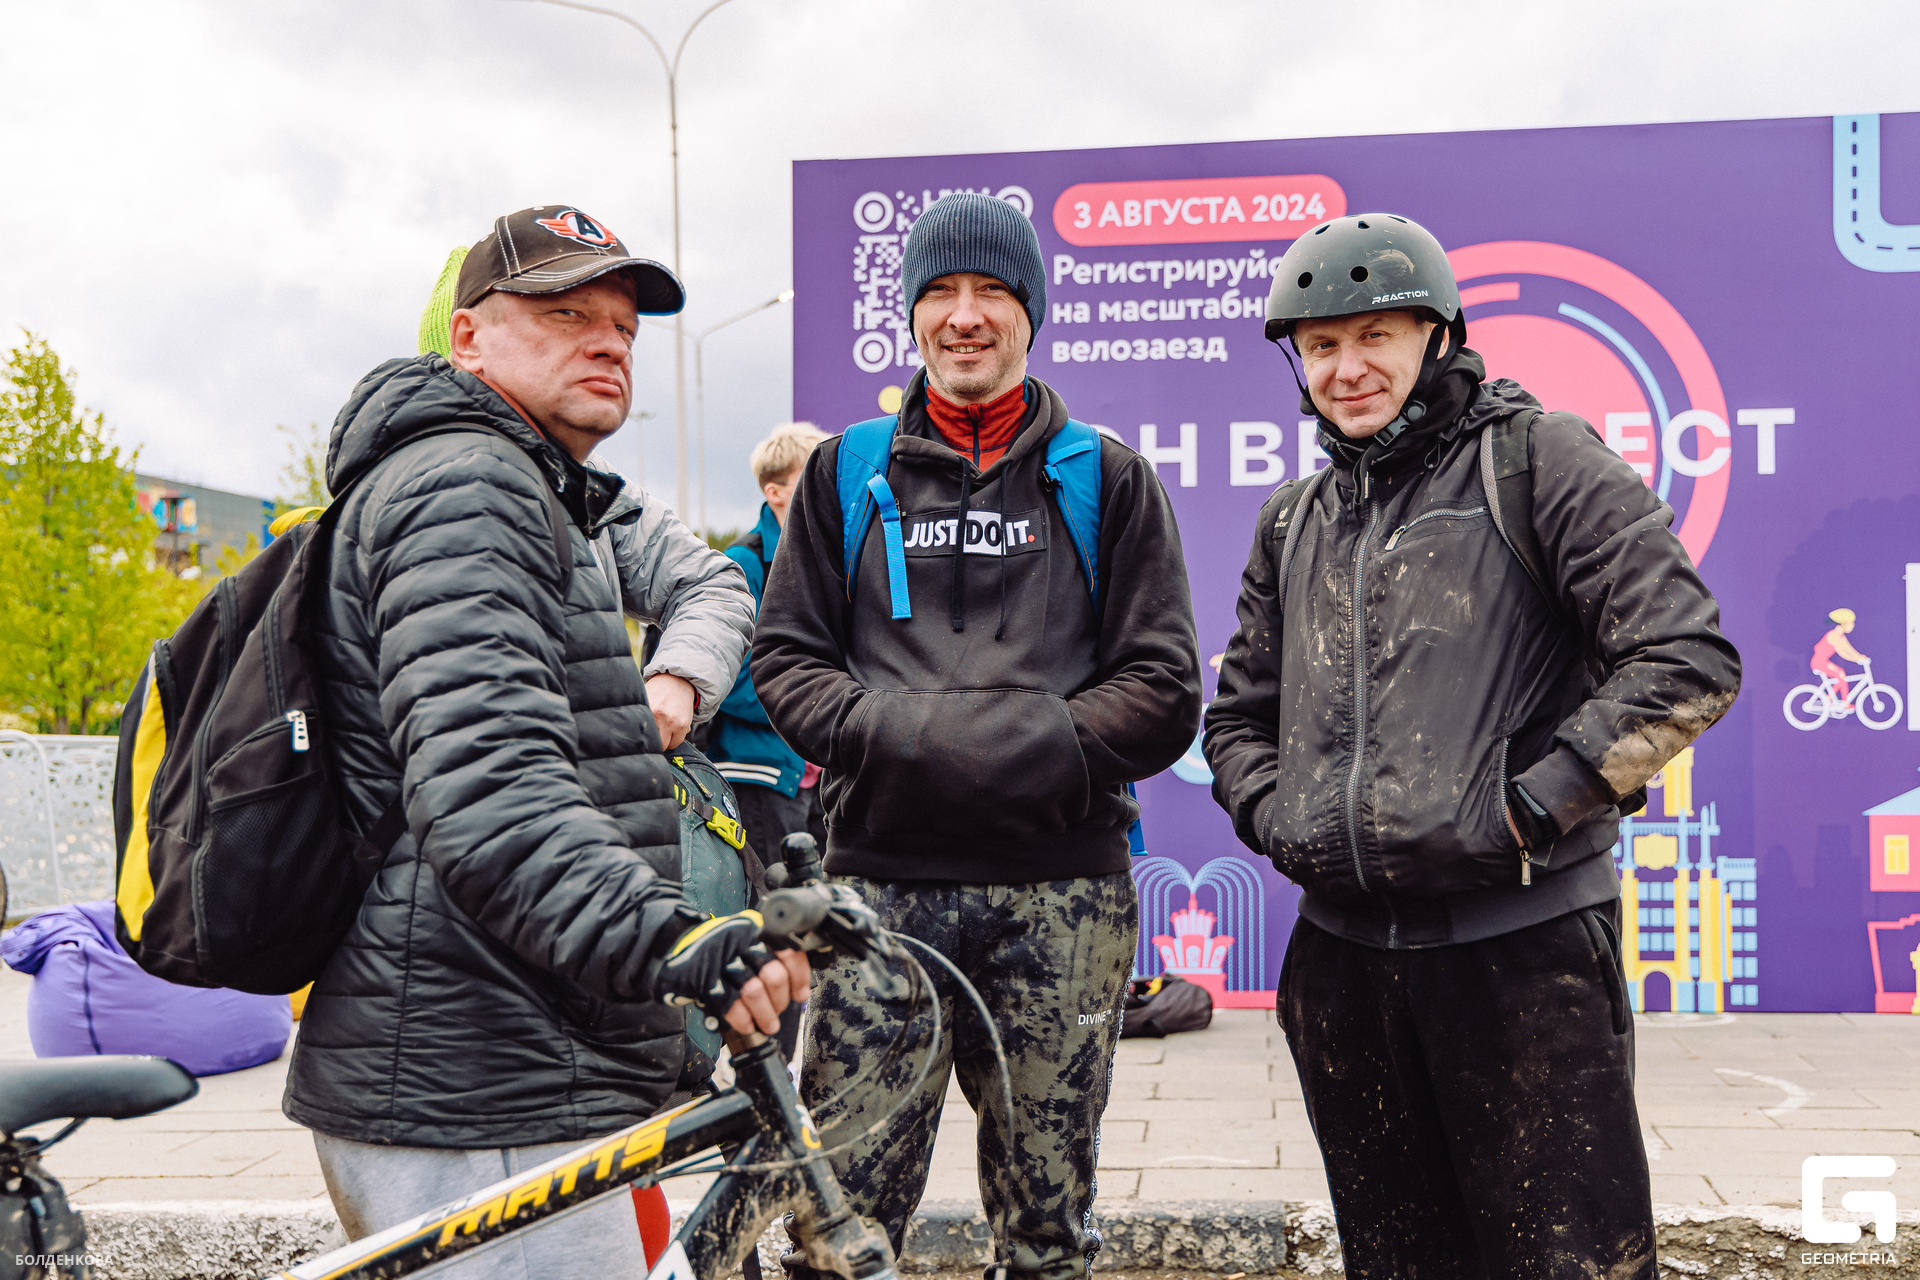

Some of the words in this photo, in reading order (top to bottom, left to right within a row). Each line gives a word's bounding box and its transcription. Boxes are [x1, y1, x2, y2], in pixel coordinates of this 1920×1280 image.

[1073, 201, 1092, 229] 3
[1097, 196, 1246, 228] АВГУСТА
[1251, 192, 1326, 222] 2024
[1371, 289, 1429, 305] REACTION
[1051, 300, 1091, 324] на
[1051, 336, 1229, 363] велозаезд
[904, 518, 959, 548] JUST
[966, 519, 1002, 547] DO
[438, 1116, 672, 1248] MATTS
